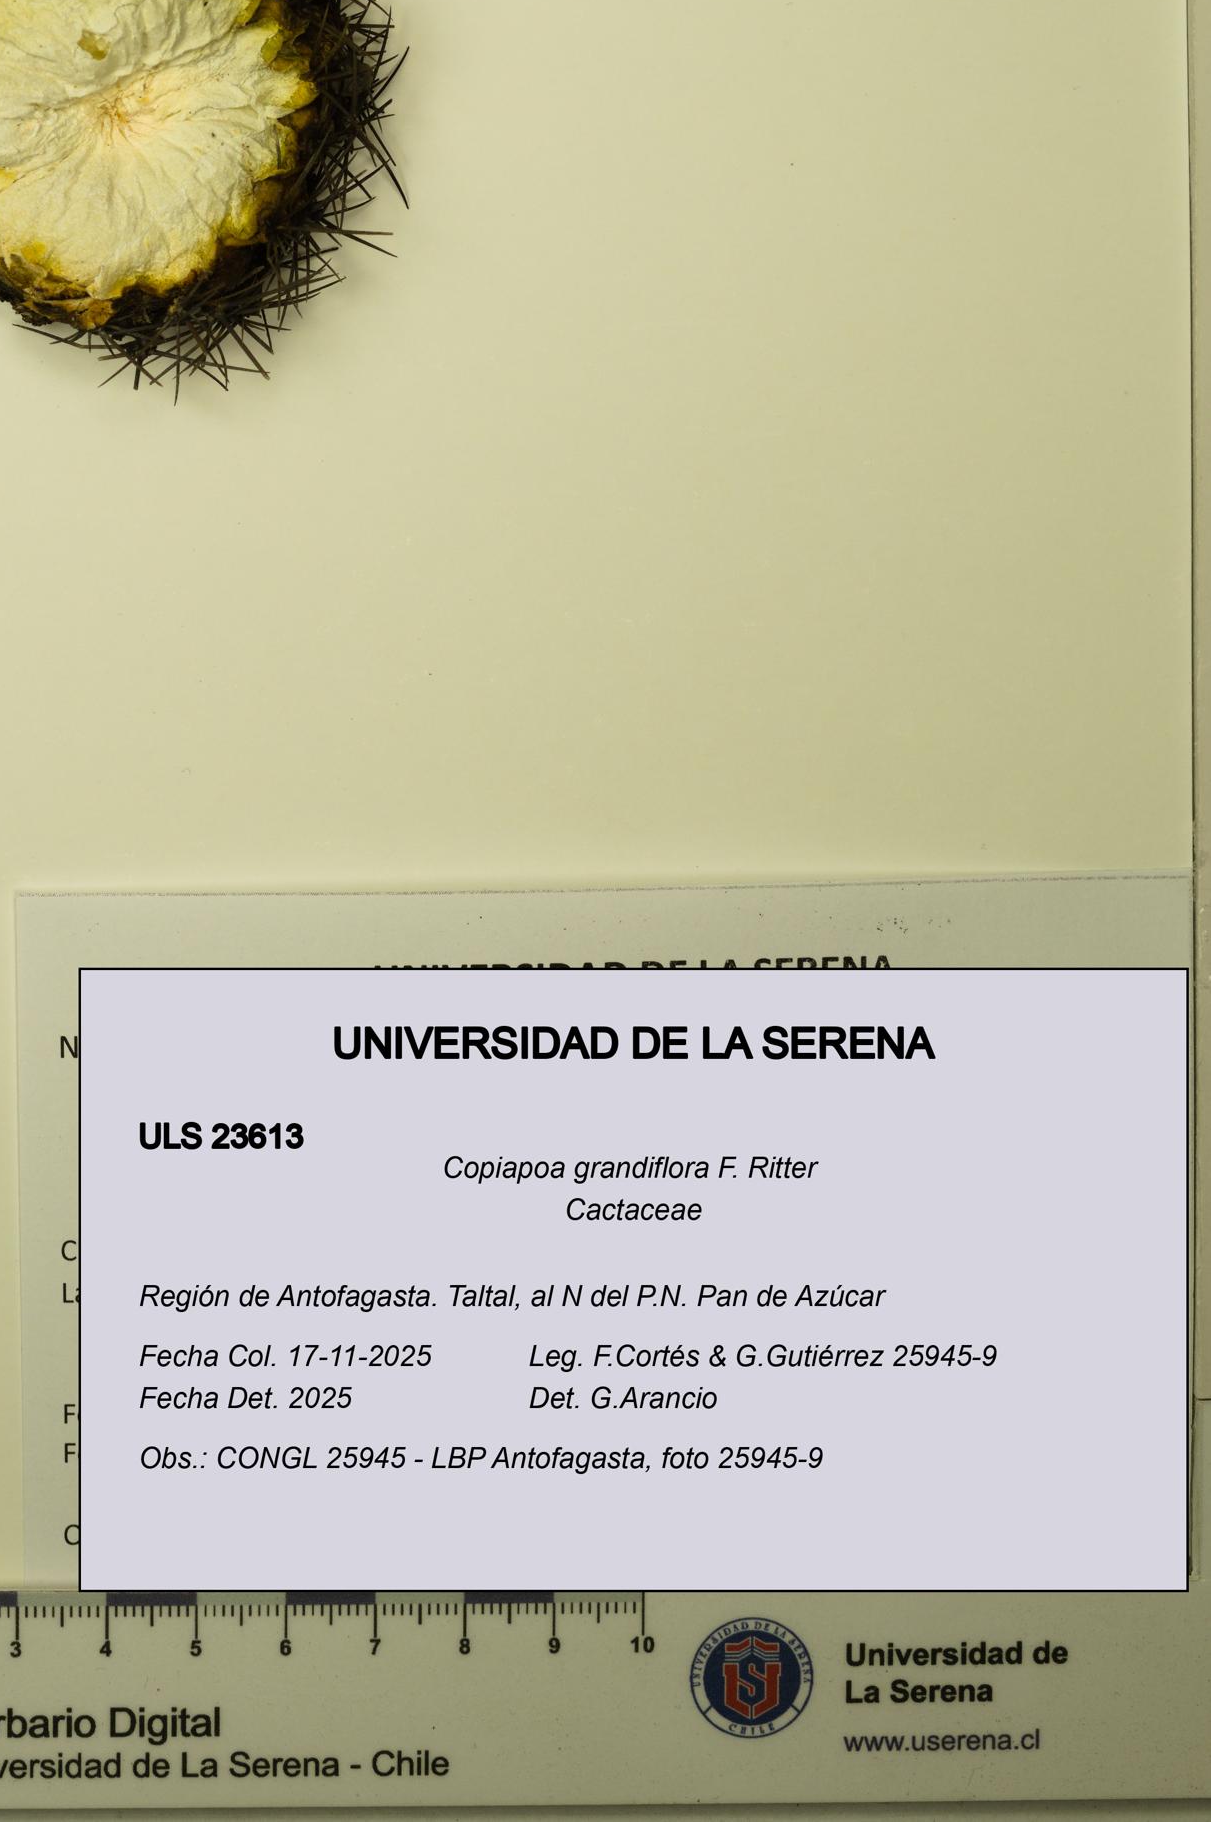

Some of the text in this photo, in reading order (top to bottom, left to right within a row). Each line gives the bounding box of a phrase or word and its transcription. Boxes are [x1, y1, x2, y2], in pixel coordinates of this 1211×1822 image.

[9, 1640, 22, 1659] 3
[99, 1639, 113, 1658] 4
[189, 1639, 203, 1658] 5
[279, 1638, 292, 1657] 6
[369, 1638, 382, 1656] 7
[458, 1637, 471, 1656] 8
[548, 1636, 562, 1655] 9
[630, 1636, 656, 1654] 10
[845, 1639, 1069, 1668] Universidad de
[845, 1678, 994, 1704] La Serena
[109, 1706, 221, 1746] Digital
[843, 1728, 1040, 1753] www.userena.cl
[132, 1751, 171, 1779] de
[181, 1751, 218, 1779] La
[228, 1750, 340, 1779] Serena
[371, 1749, 450, 1777] Chile
